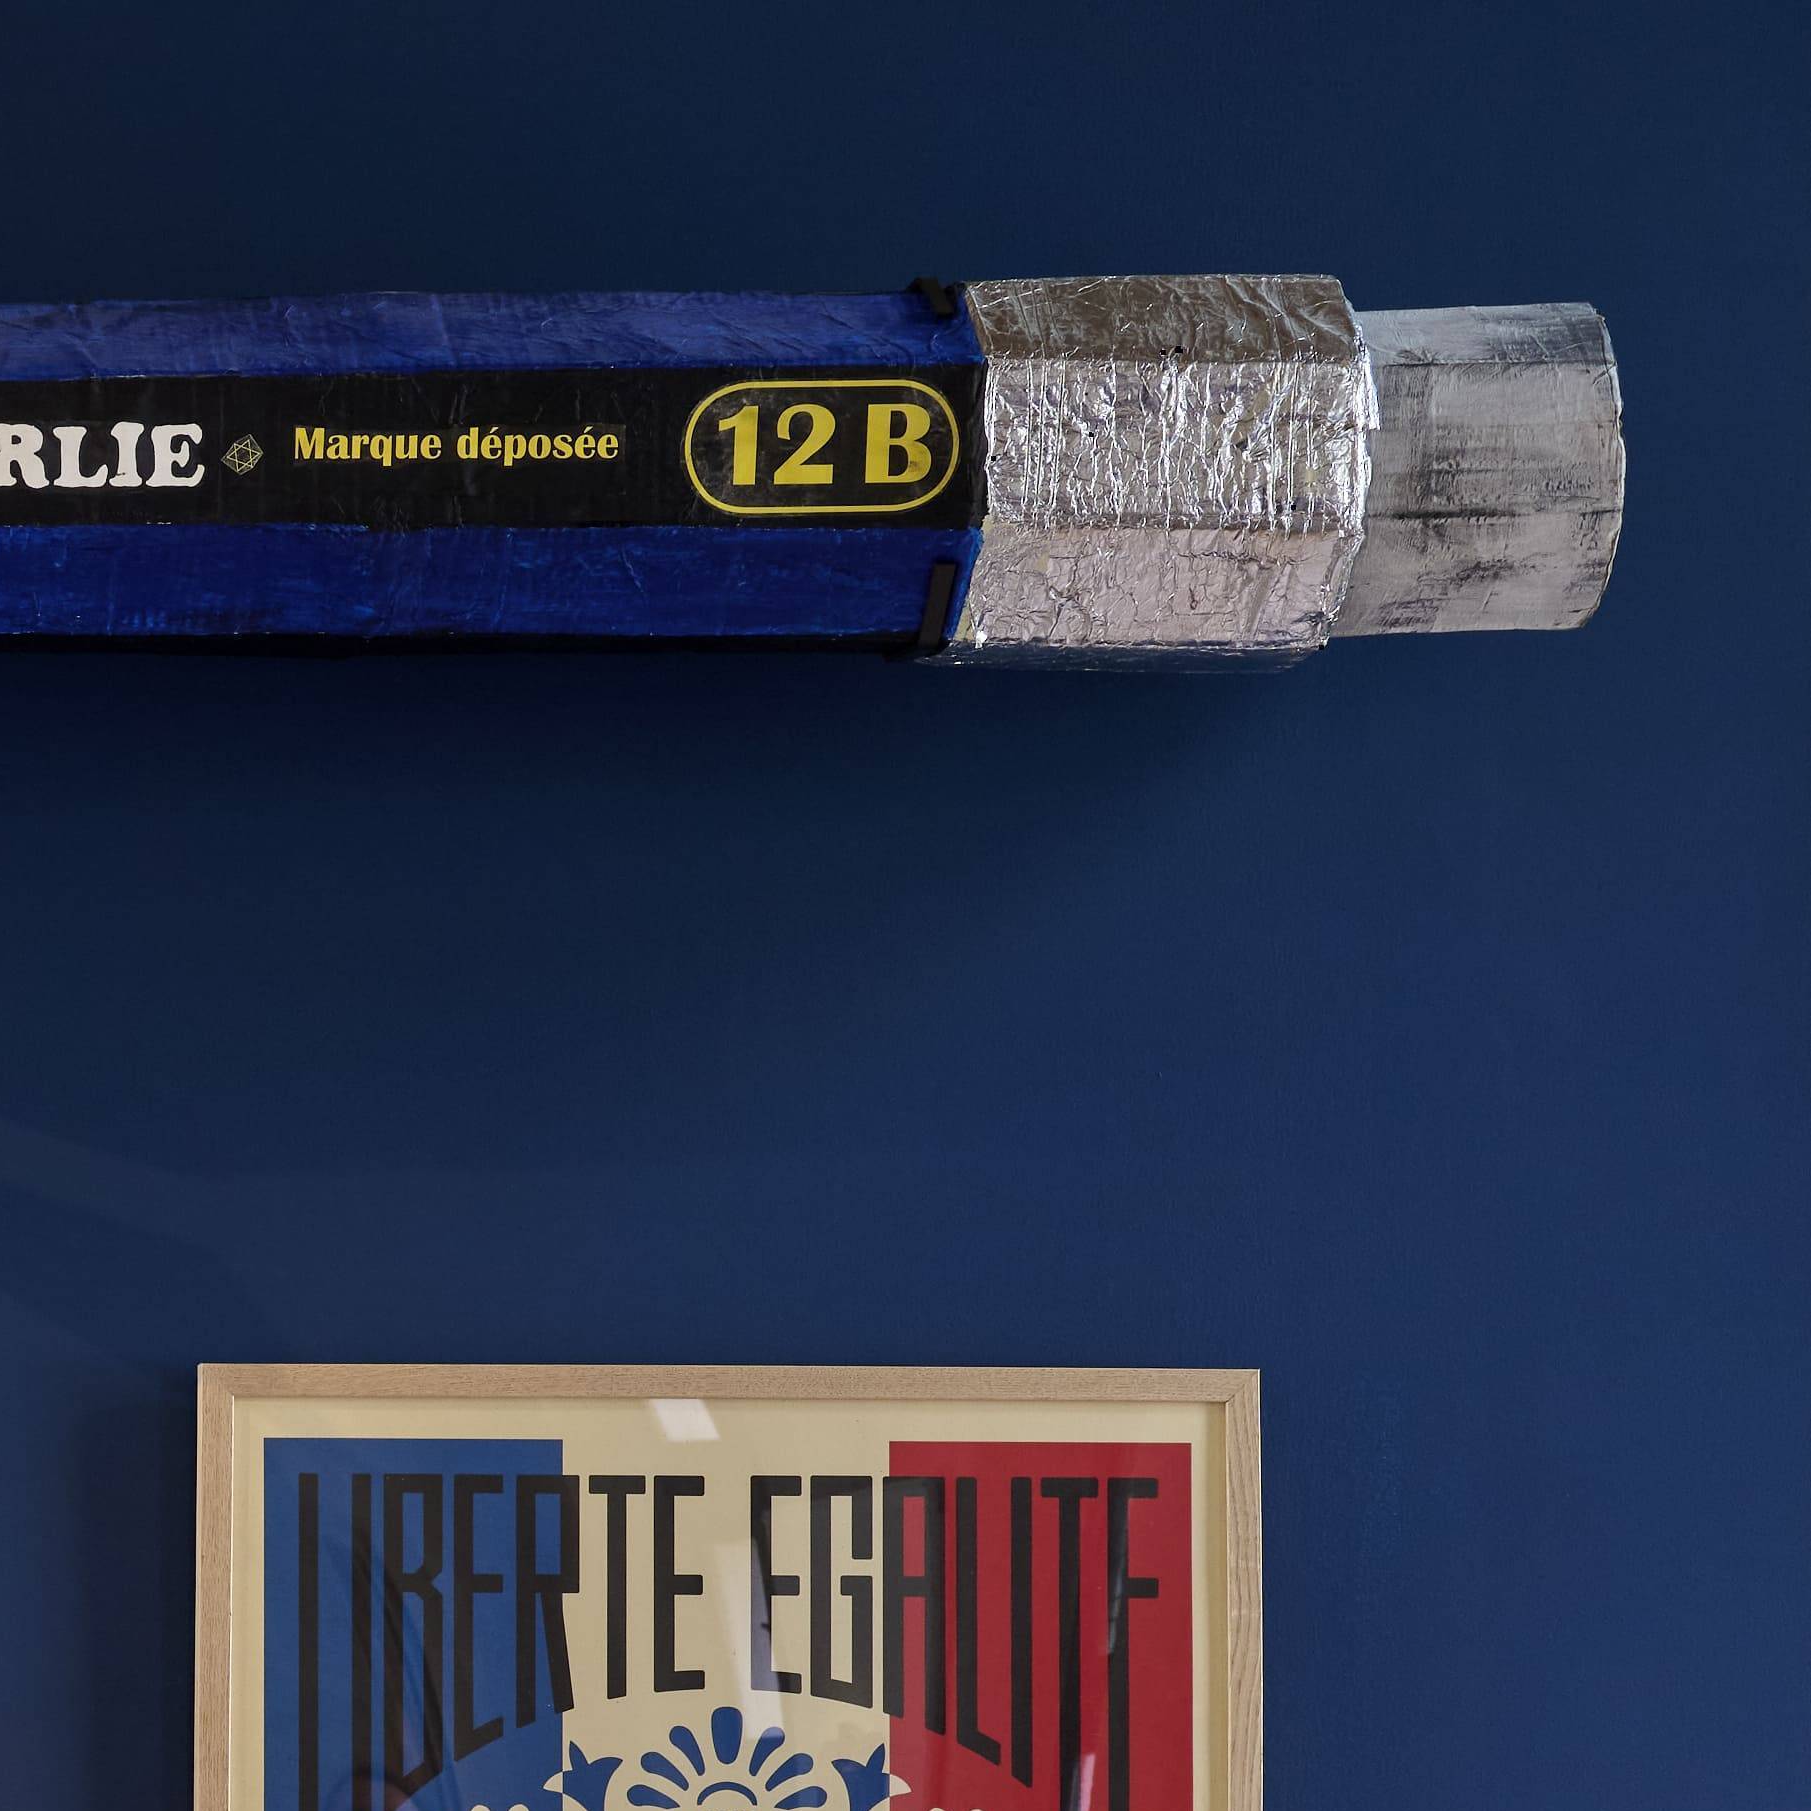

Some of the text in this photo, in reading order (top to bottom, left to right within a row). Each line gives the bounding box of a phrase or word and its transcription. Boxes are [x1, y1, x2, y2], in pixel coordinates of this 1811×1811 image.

[294, 425, 443, 466] Marque
[457, 425, 620, 466] déposée
[717, 404, 835, 486] 12
[866, 404, 933, 485] B
